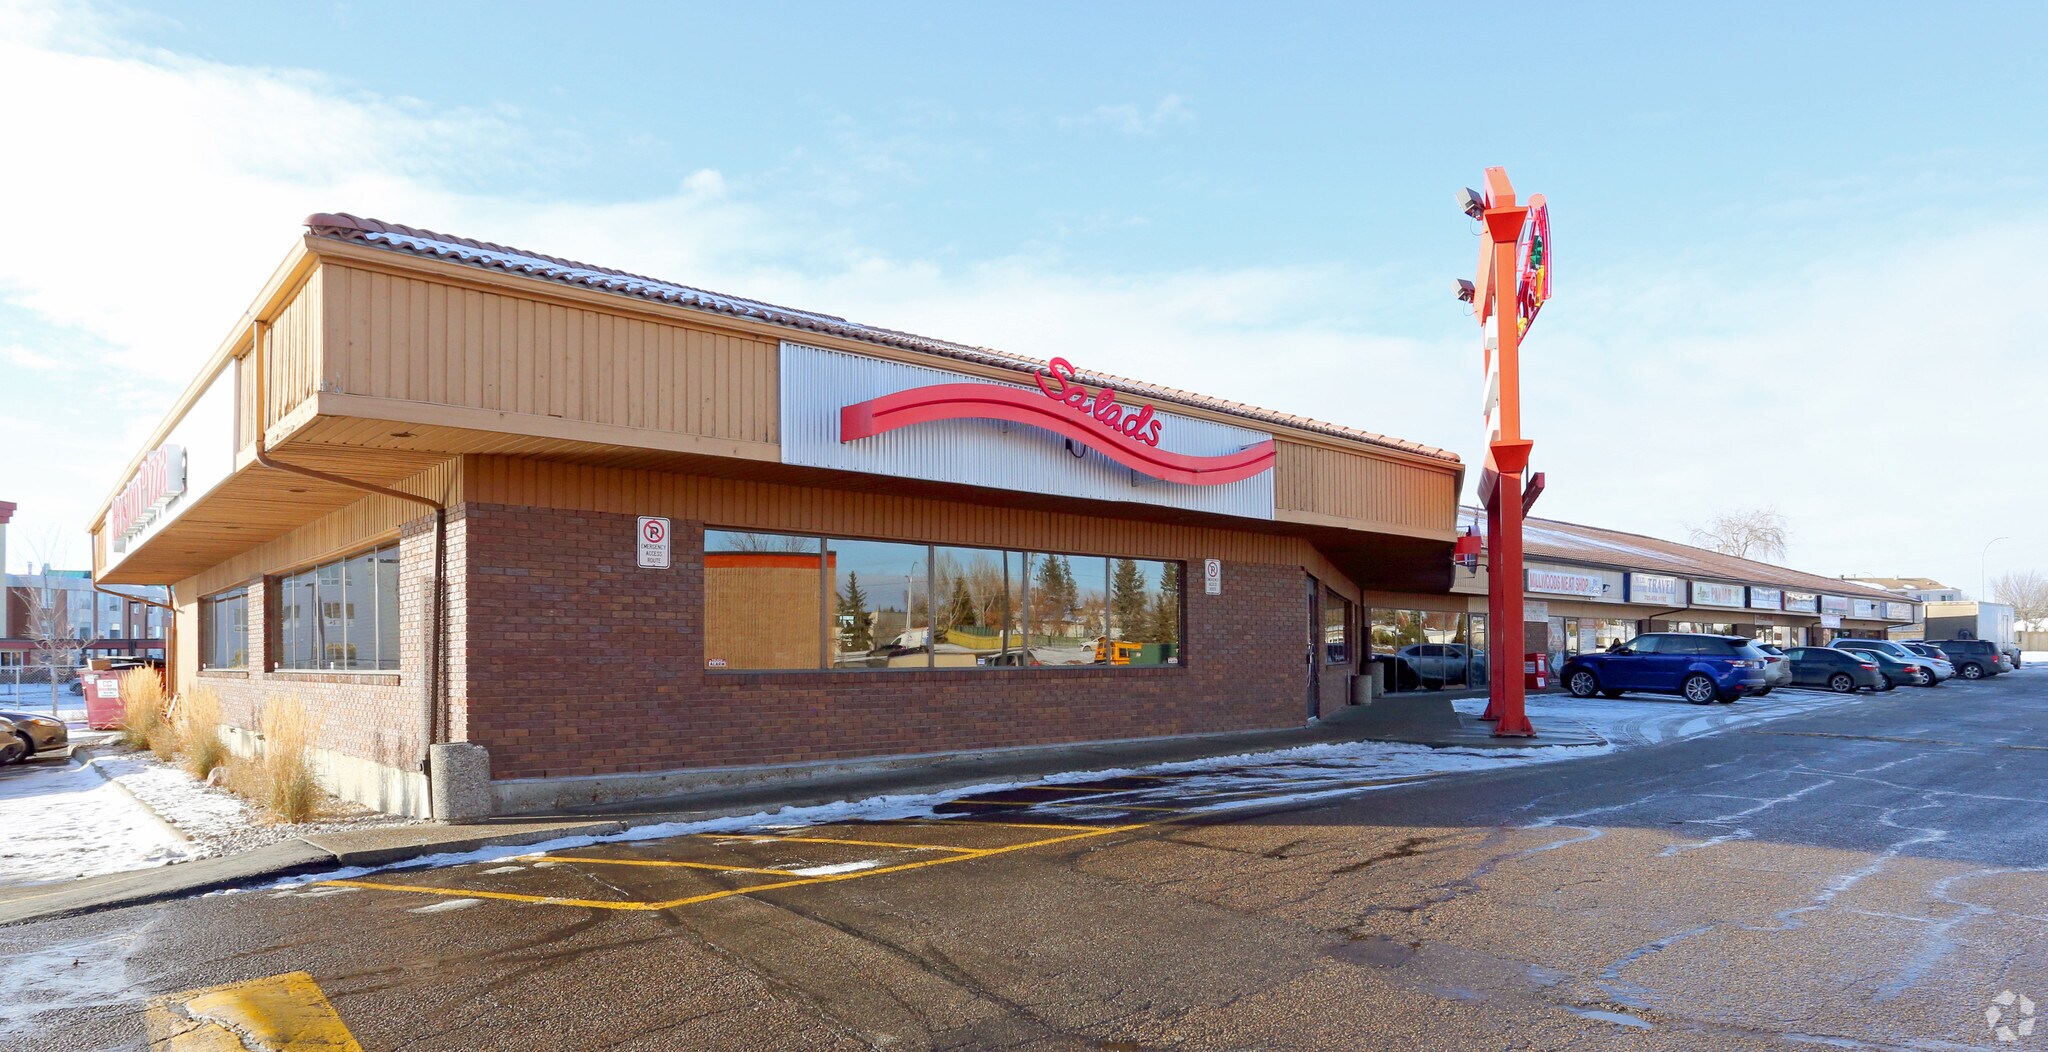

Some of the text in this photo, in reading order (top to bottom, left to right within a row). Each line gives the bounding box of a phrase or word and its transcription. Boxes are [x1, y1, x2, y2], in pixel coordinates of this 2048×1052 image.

[1034, 357, 1162, 446] Salads
[1530, 573, 1560, 589] MILLWOODS
[1561, 575, 1575, 591] MEAT
[1576, 577, 1589, 592] SHOP
[1648, 578, 1677, 594] TRAVEL
